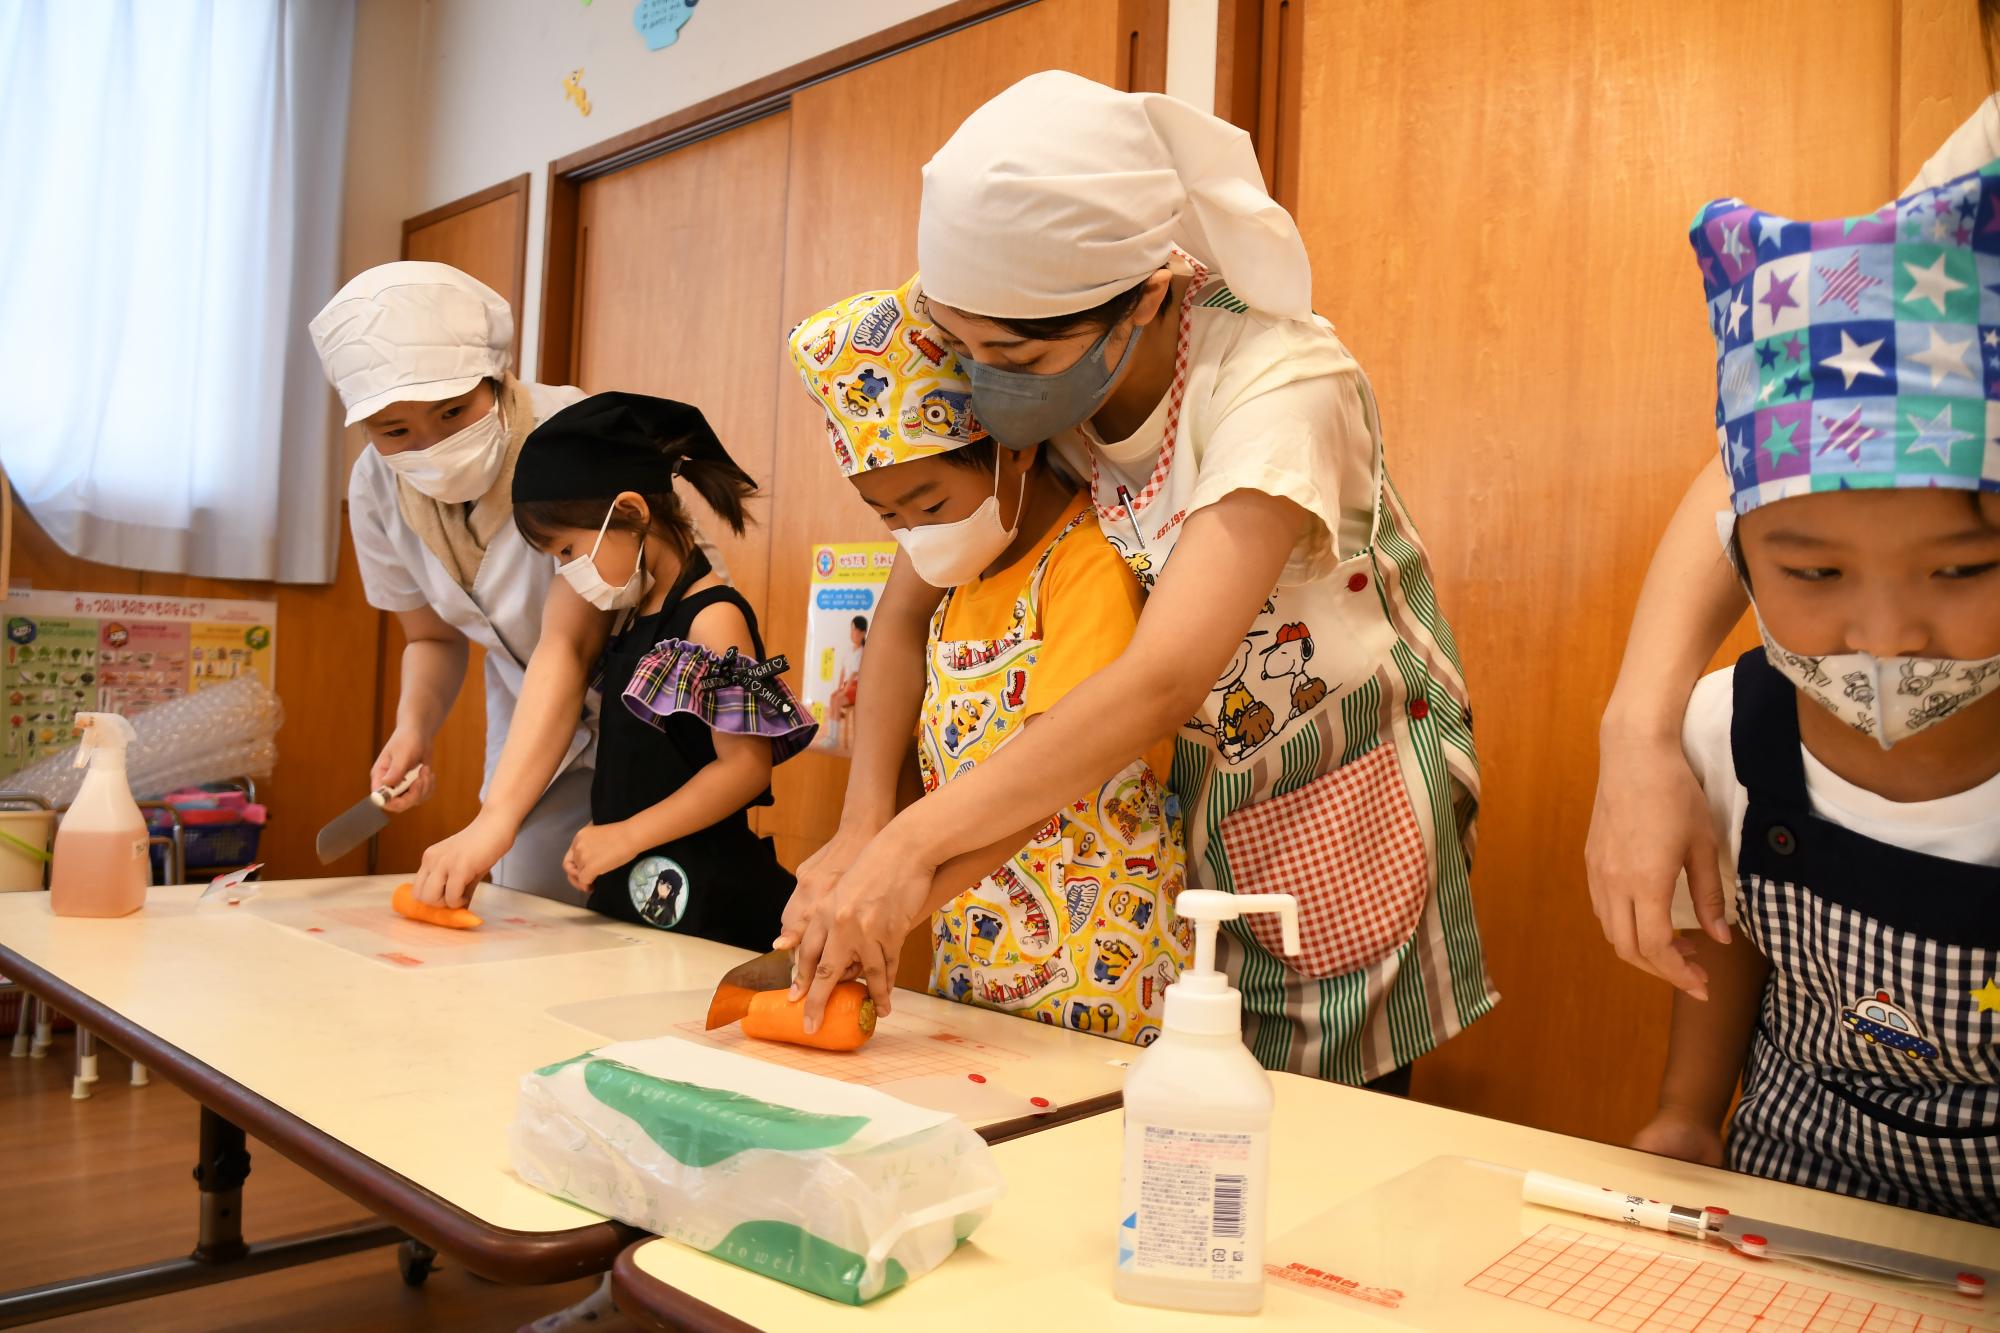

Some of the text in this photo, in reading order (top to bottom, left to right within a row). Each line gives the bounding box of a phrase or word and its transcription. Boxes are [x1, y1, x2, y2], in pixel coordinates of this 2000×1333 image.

[854, 297, 896, 345] SUPER SILLY
[871, 310, 896, 346] FUN LAND
[1170, 509, 1187, 528] 195
[747, 662, 771, 677] RIGHT
[760, 687, 782, 707] SMILE
[1068, 885, 1080, 902] FUN
[1077, 884, 1098, 915] SUPER
